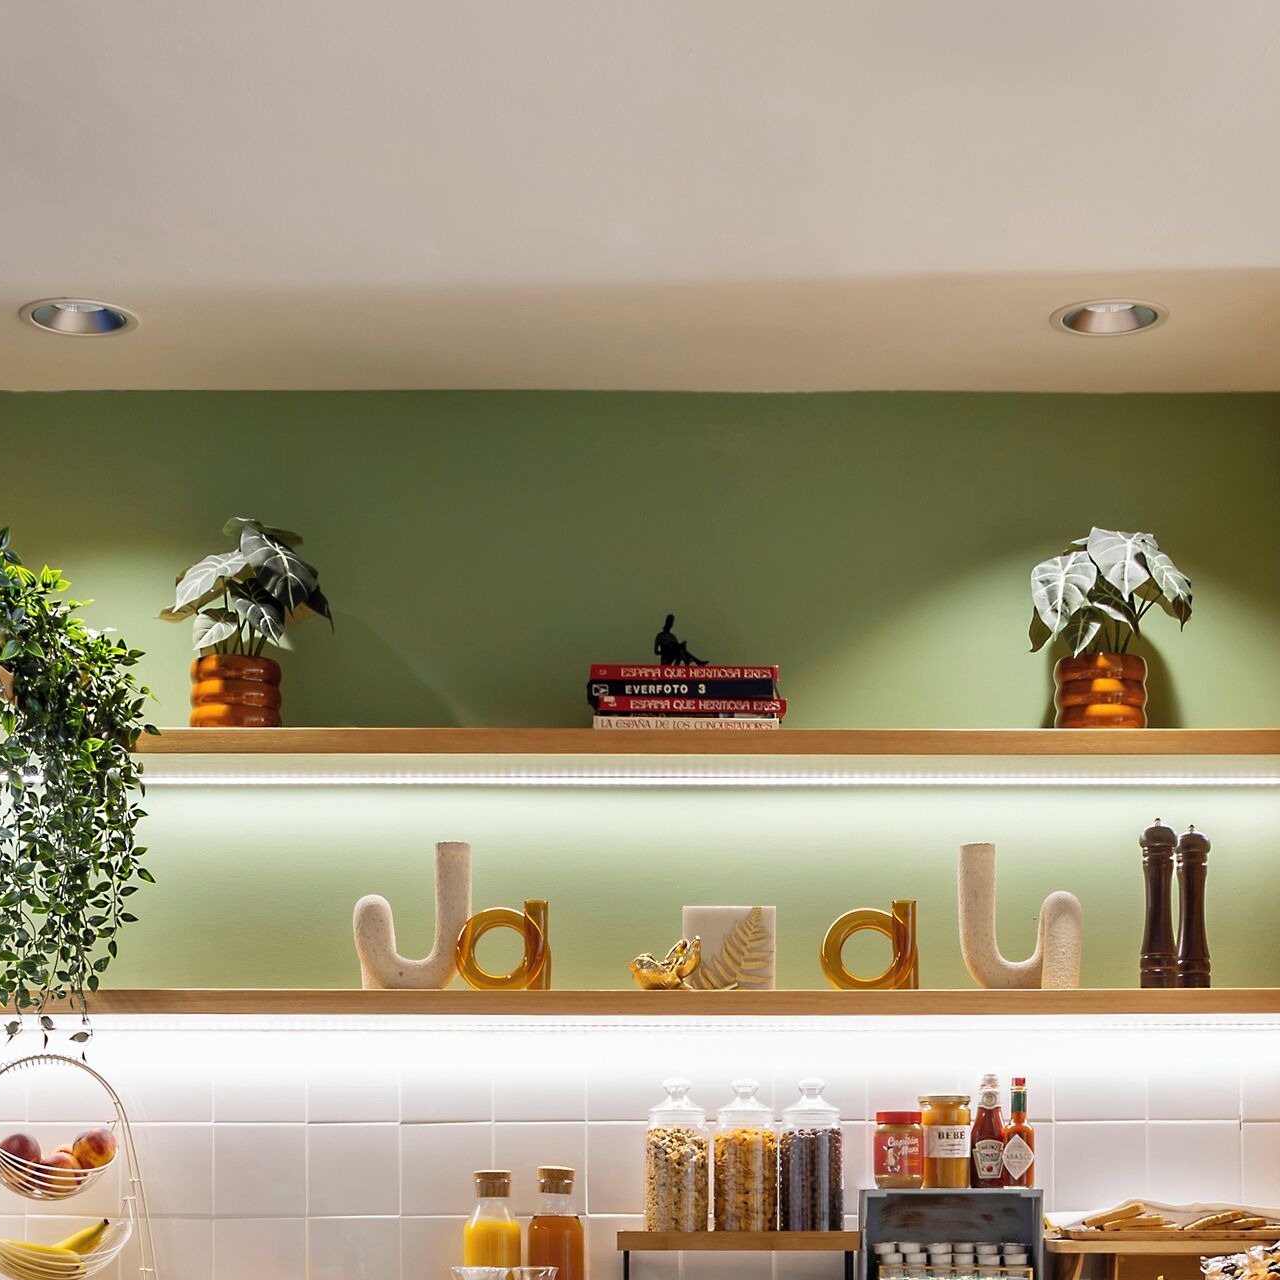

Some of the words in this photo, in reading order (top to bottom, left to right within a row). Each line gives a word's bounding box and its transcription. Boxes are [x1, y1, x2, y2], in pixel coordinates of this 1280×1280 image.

[664, 668, 687, 679] QUE
[689, 668, 741, 679] HERMOSA
[744, 668, 772, 679] ERES
[625, 684, 689, 695] EVERFOTO
[698, 684, 707, 695] 3
[673, 700, 696, 711] QUE
[698, 701, 750, 711] HERMOSA
[753, 701, 782, 712] ERES
[600, 719, 613, 729] LA
[615, 718, 651, 729] ESPAÑA
[655, 720, 669, 729] DE
[672, 720, 691, 729] LOS
